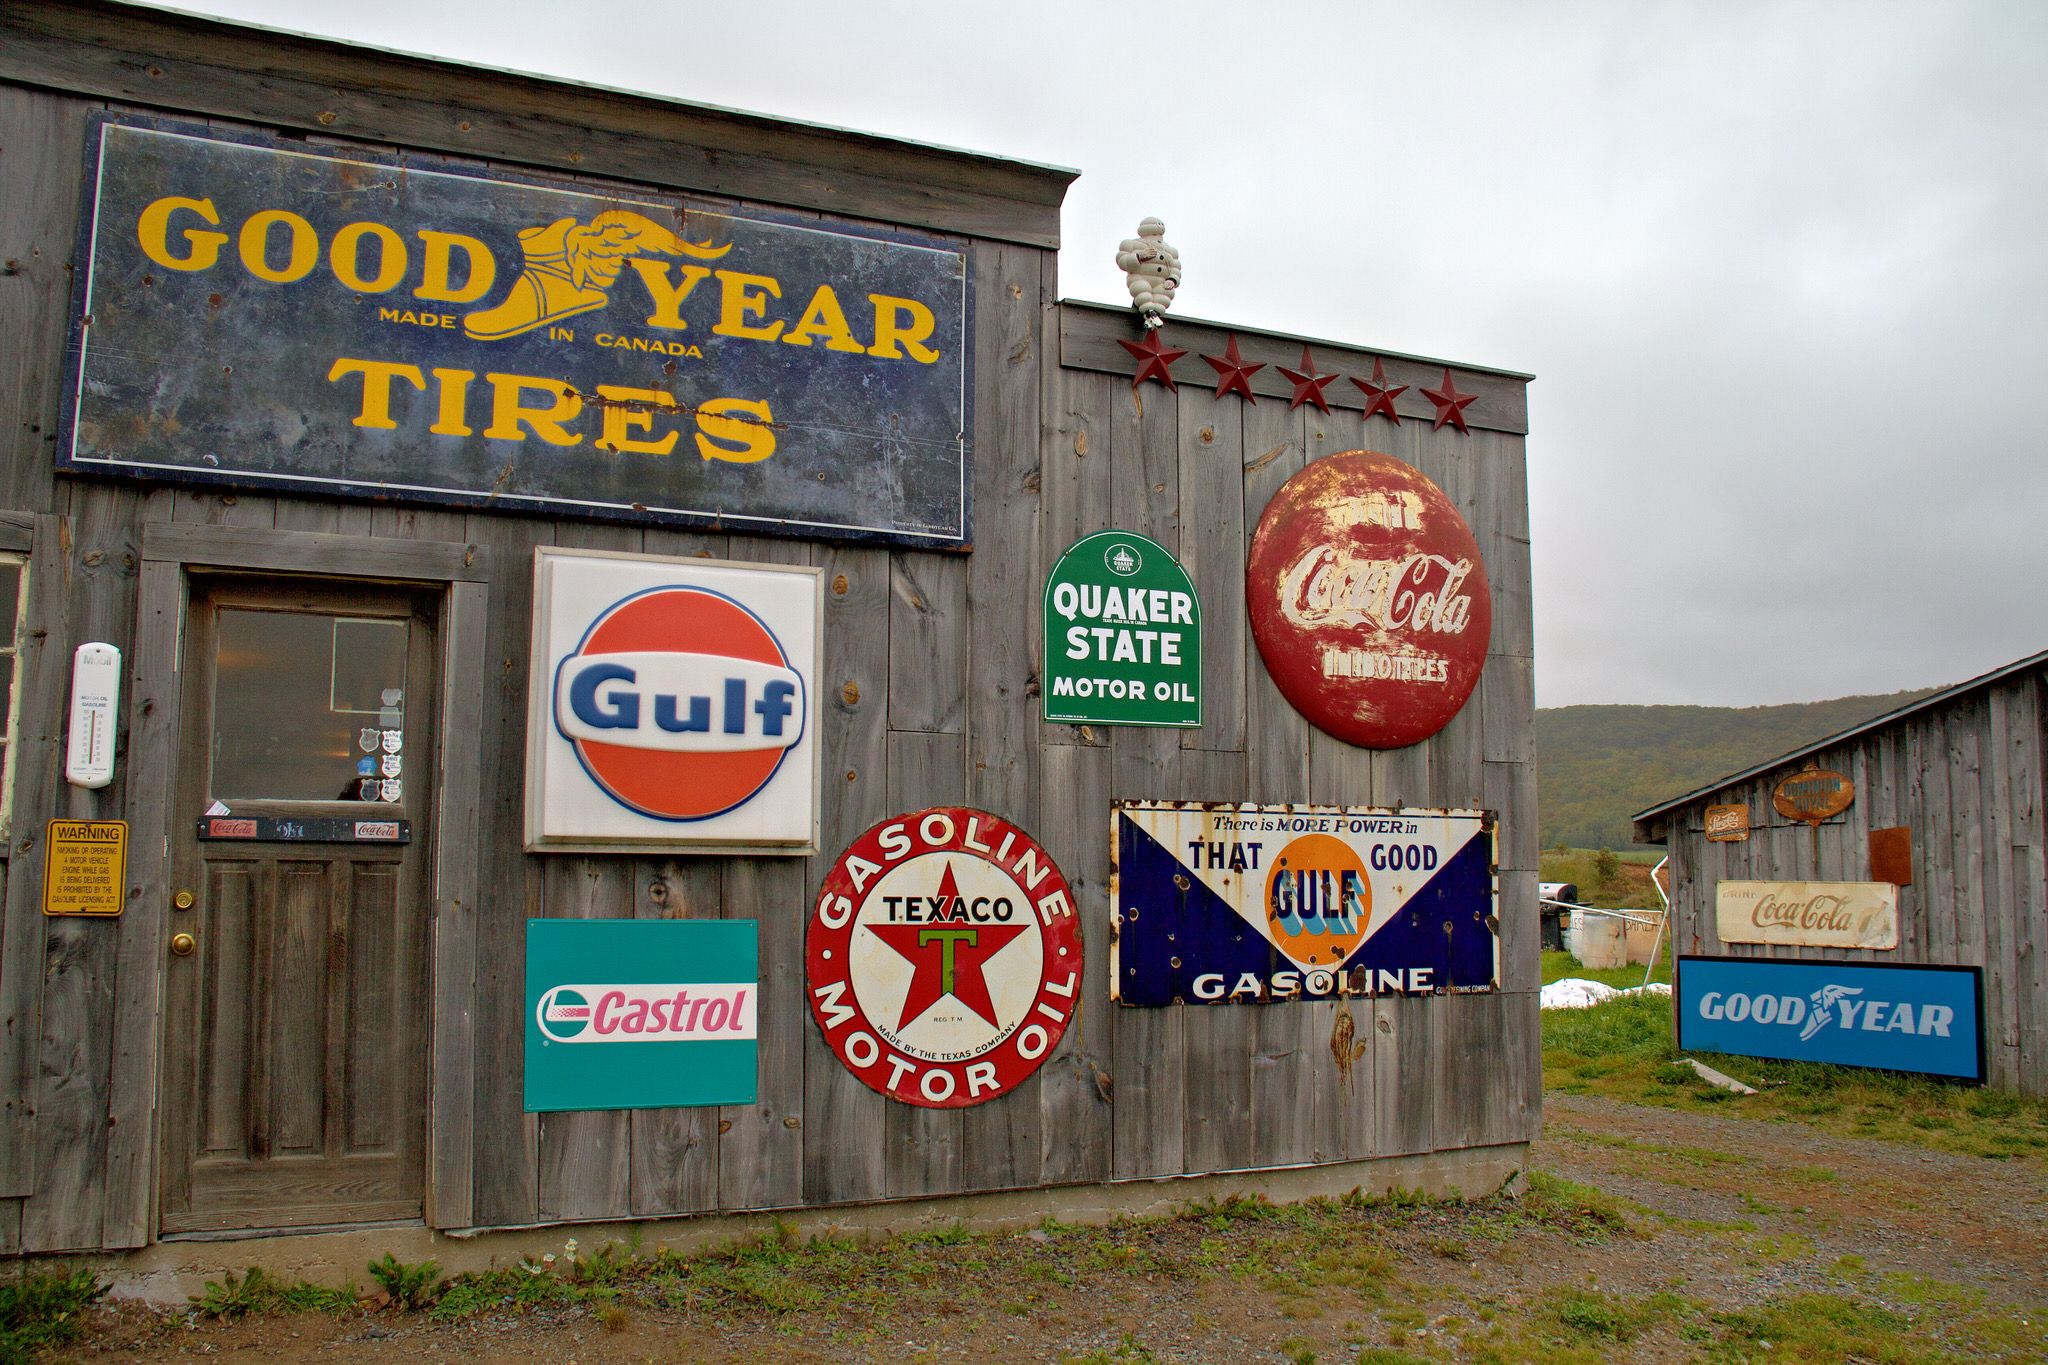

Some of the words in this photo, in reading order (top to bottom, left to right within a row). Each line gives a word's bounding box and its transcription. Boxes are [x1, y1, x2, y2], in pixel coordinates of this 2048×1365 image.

[137, 196, 496, 304] GOOD
[630, 259, 940, 365] YEAR
[379, 307, 457, 330] MADE
[550, 327, 574, 342] IN
[595, 332, 704, 360] CANADA
[327, 357, 778, 465] TIRES
[1053, 582, 1194, 625] QUAKER
[1065, 625, 1182, 666] STATE
[570, 662, 795, 736] Gulf
[1052, 676, 1146, 700] MOTOR
[1153, 682, 1195, 702] OIL
[57, 826, 120, 840] WARNING
[1213, 815, 1257, 831] There
[1261, 818, 1273, 831] is
[1276, 818, 1330, 833] MORE
[1334, 819, 1403, 834] POWER
[1405, 820, 1418, 834] in
[57, 846, 80, 854] SMOKING
[90, 847, 118, 855] OPERATING
[70, 856, 87, 864] MOTOR
[89, 857, 109, 865] VEHICLE
[1188, 840, 1262, 871] THAT
[1370, 843, 1438, 872] GOOD
[62, 866, 80, 874] ENGINE
[66, 876, 81, 884] BEING
[83, 876, 110, 884] DELIVERED
[819, 813, 1071, 930] GASOLINE
[52, 895, 77, 903] GASOLINE
[79, 895, 104, 903] LICENSING
[105, 896, 116, 904] ACT
[63, 885, 92, 894] PROHIBITED
[103, 886, 112, 894] THE
[1271, 868, 1362, 932] GULF
[882, 896, 1013, 923] TEXACO
[1192, 967, 1434, 1000] GASOLINE
[593, 990, 747, 1035] Castrol
[1699, 991, 1807, 1025] GOOD
[1838, 1000, 1954, 1038] YEAR
[815, 980, 1001, 1102] MOTOR
[1016, 971, 1077, 1060] OIL
[877, 1024, 901, 1047] MADE
[904, 1043, 917, 1054] BY
[919, 1049, 937, 1060] THE
[941, 1050, 971, 1060] TEXAS
[975, 1020, 1016, 1054] COMPANY
